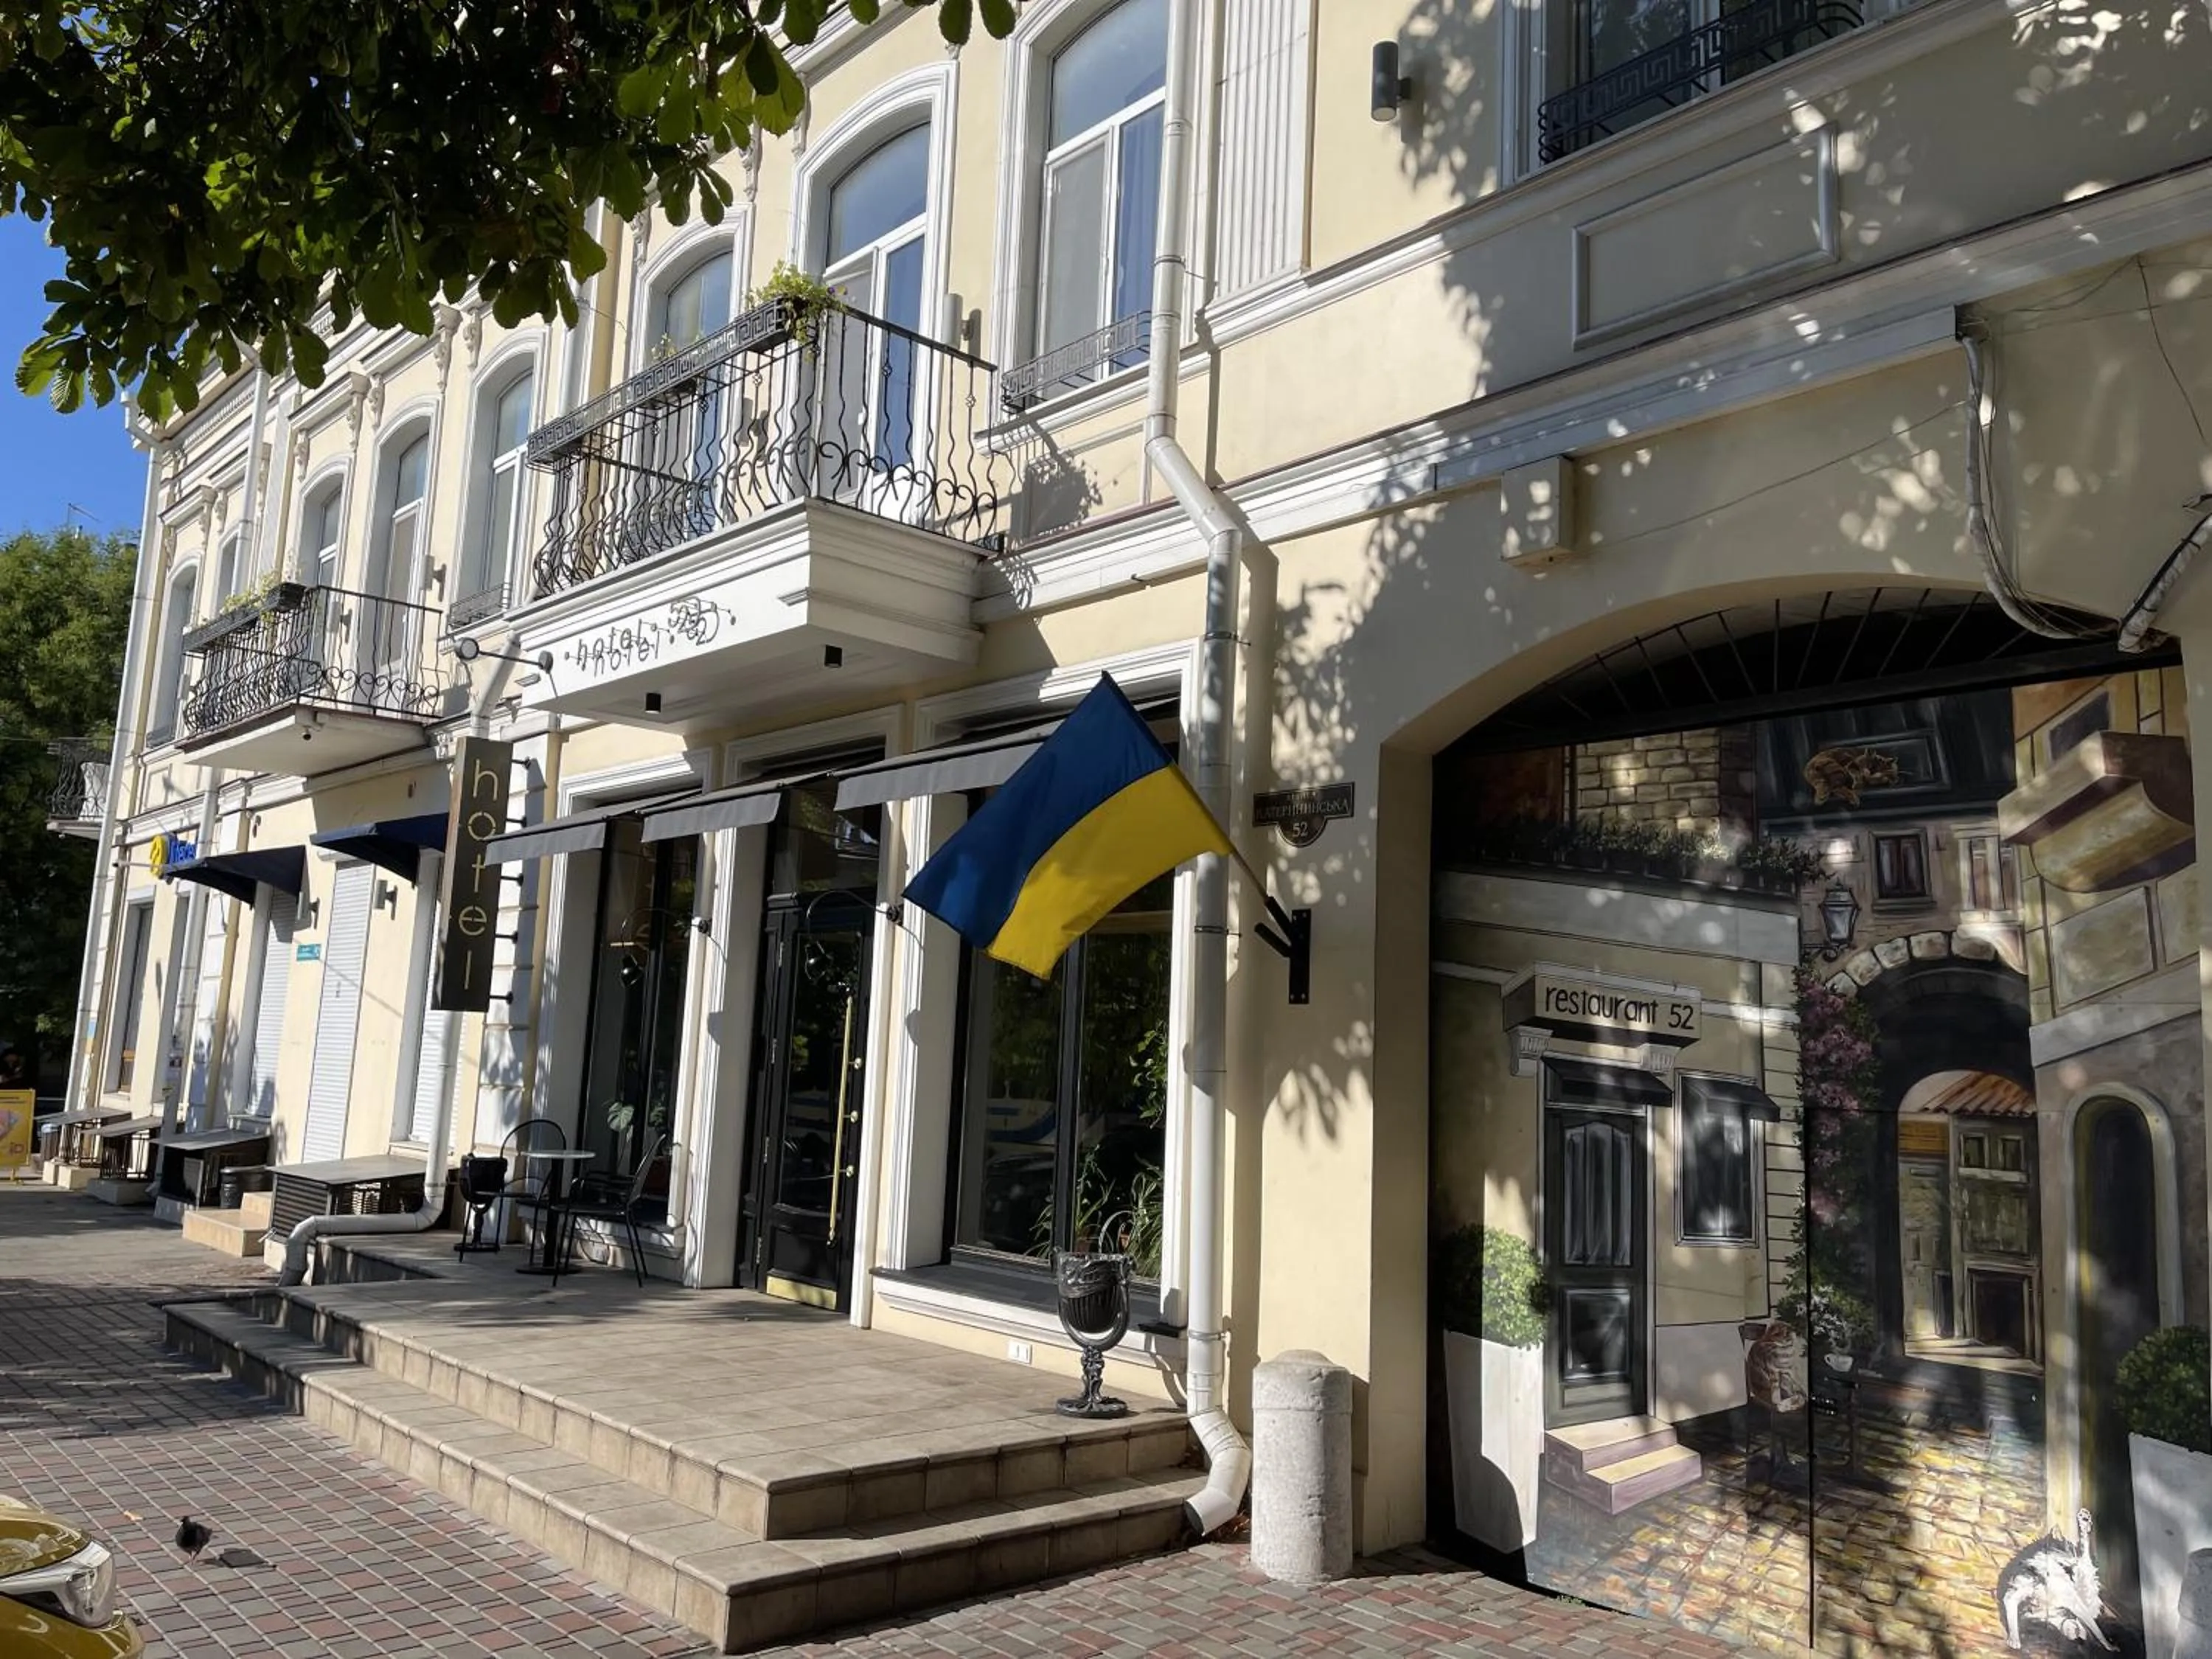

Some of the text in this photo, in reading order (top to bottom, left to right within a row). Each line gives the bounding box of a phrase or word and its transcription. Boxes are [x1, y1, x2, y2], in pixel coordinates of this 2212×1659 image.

[1292, 821, 1309, 838] 52
[459, 759, 498, 990] hotel
[1545, 986, 1695, 1029] restaurant 52
